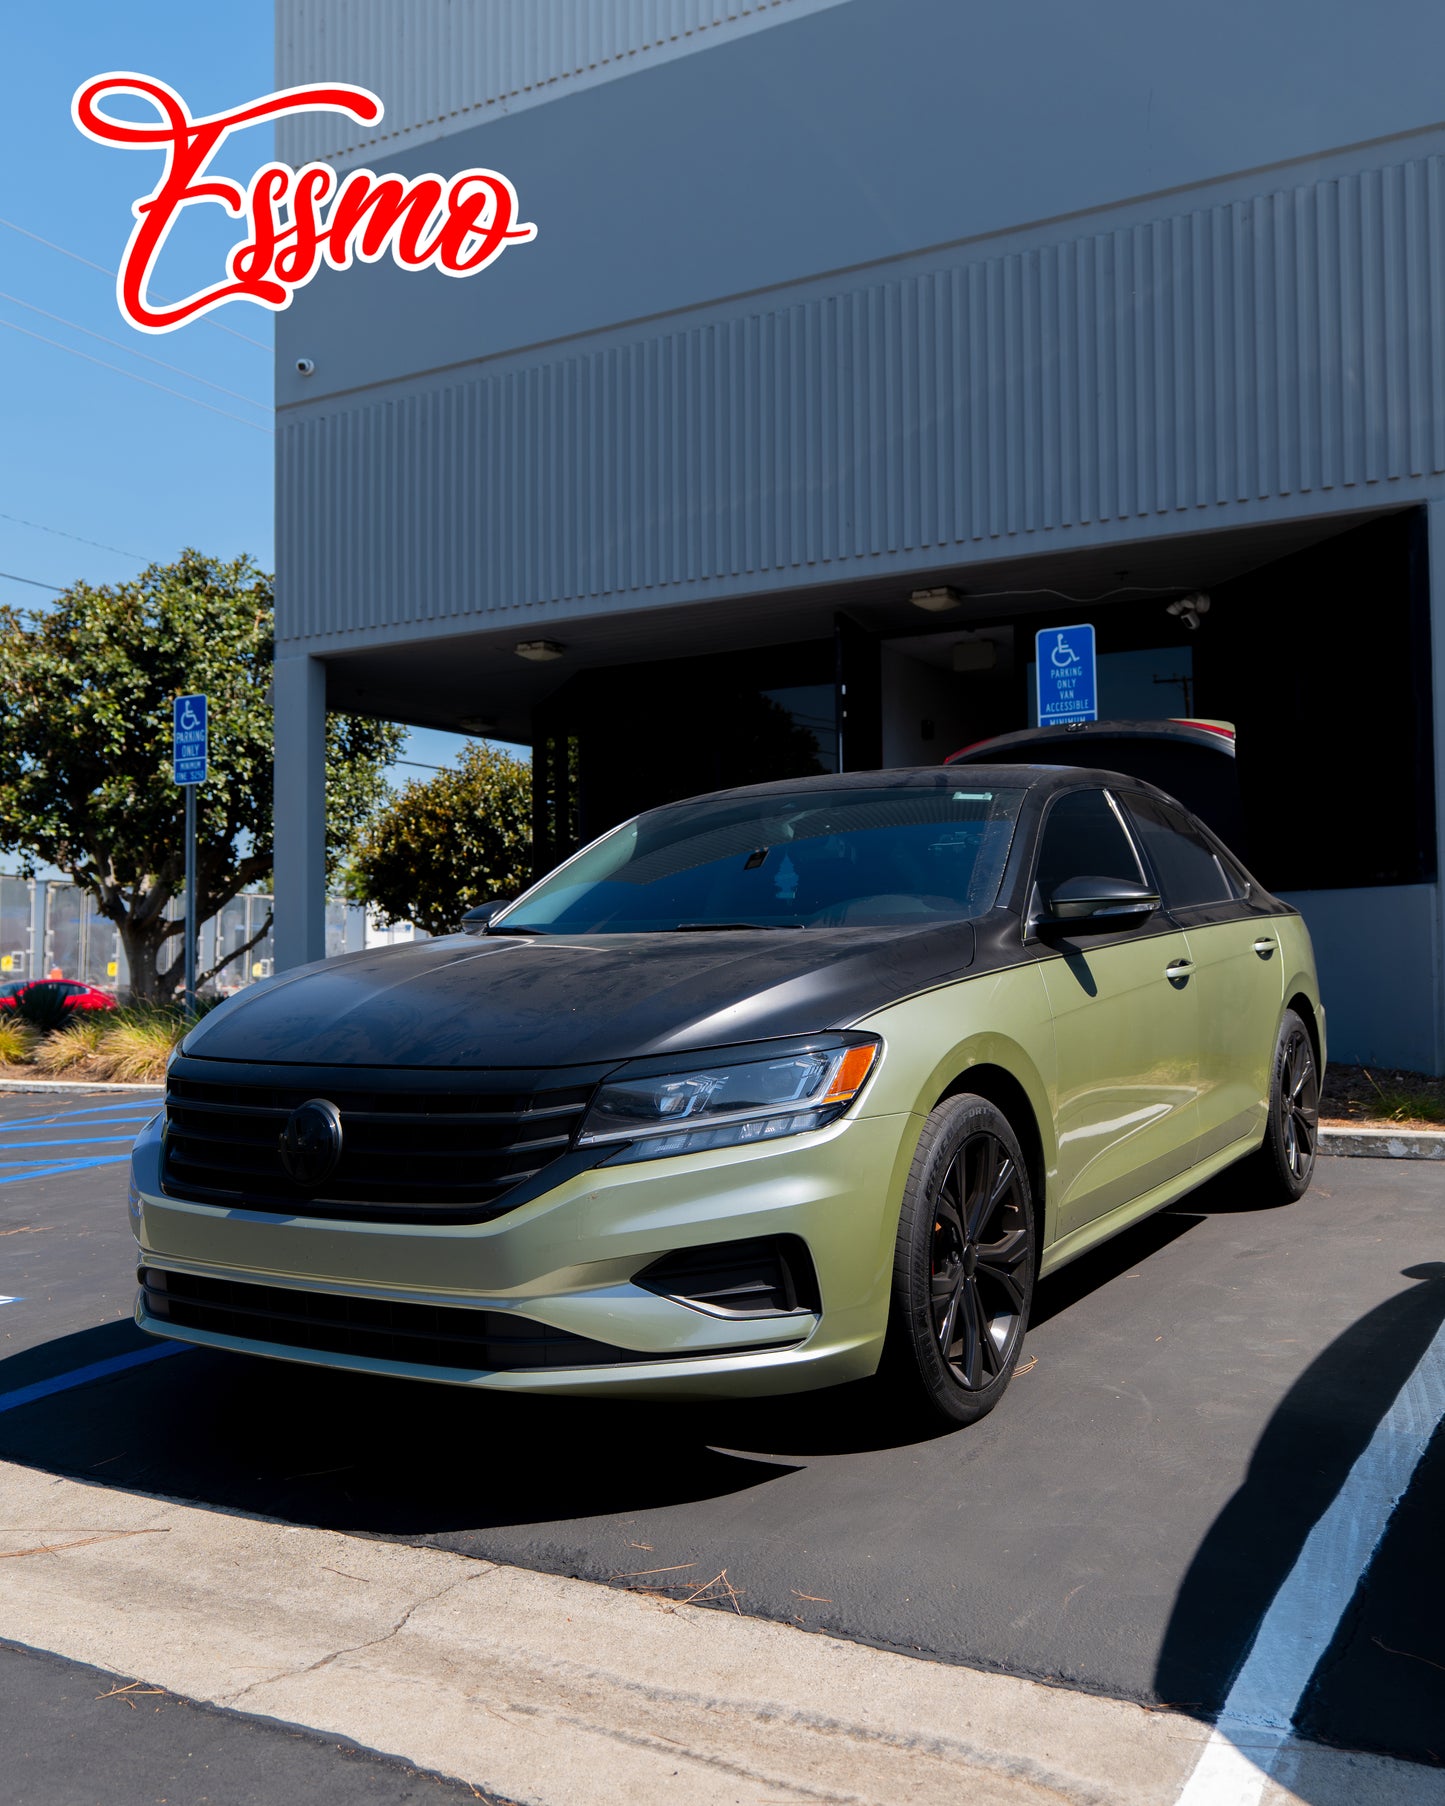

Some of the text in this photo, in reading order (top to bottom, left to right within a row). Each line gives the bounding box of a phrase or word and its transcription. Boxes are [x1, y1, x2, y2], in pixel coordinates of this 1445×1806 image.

[1050, 666, 1083, 679] PARKING
[1057, 678, 1076, 689] ONLY
[1060, 690, 1074, 700] VAN
[1045, 699, 1089, 713] ACCESSIBLE
[176, 729, 205, 744] PARKING
[181, 743, 200, 758] ONLY
